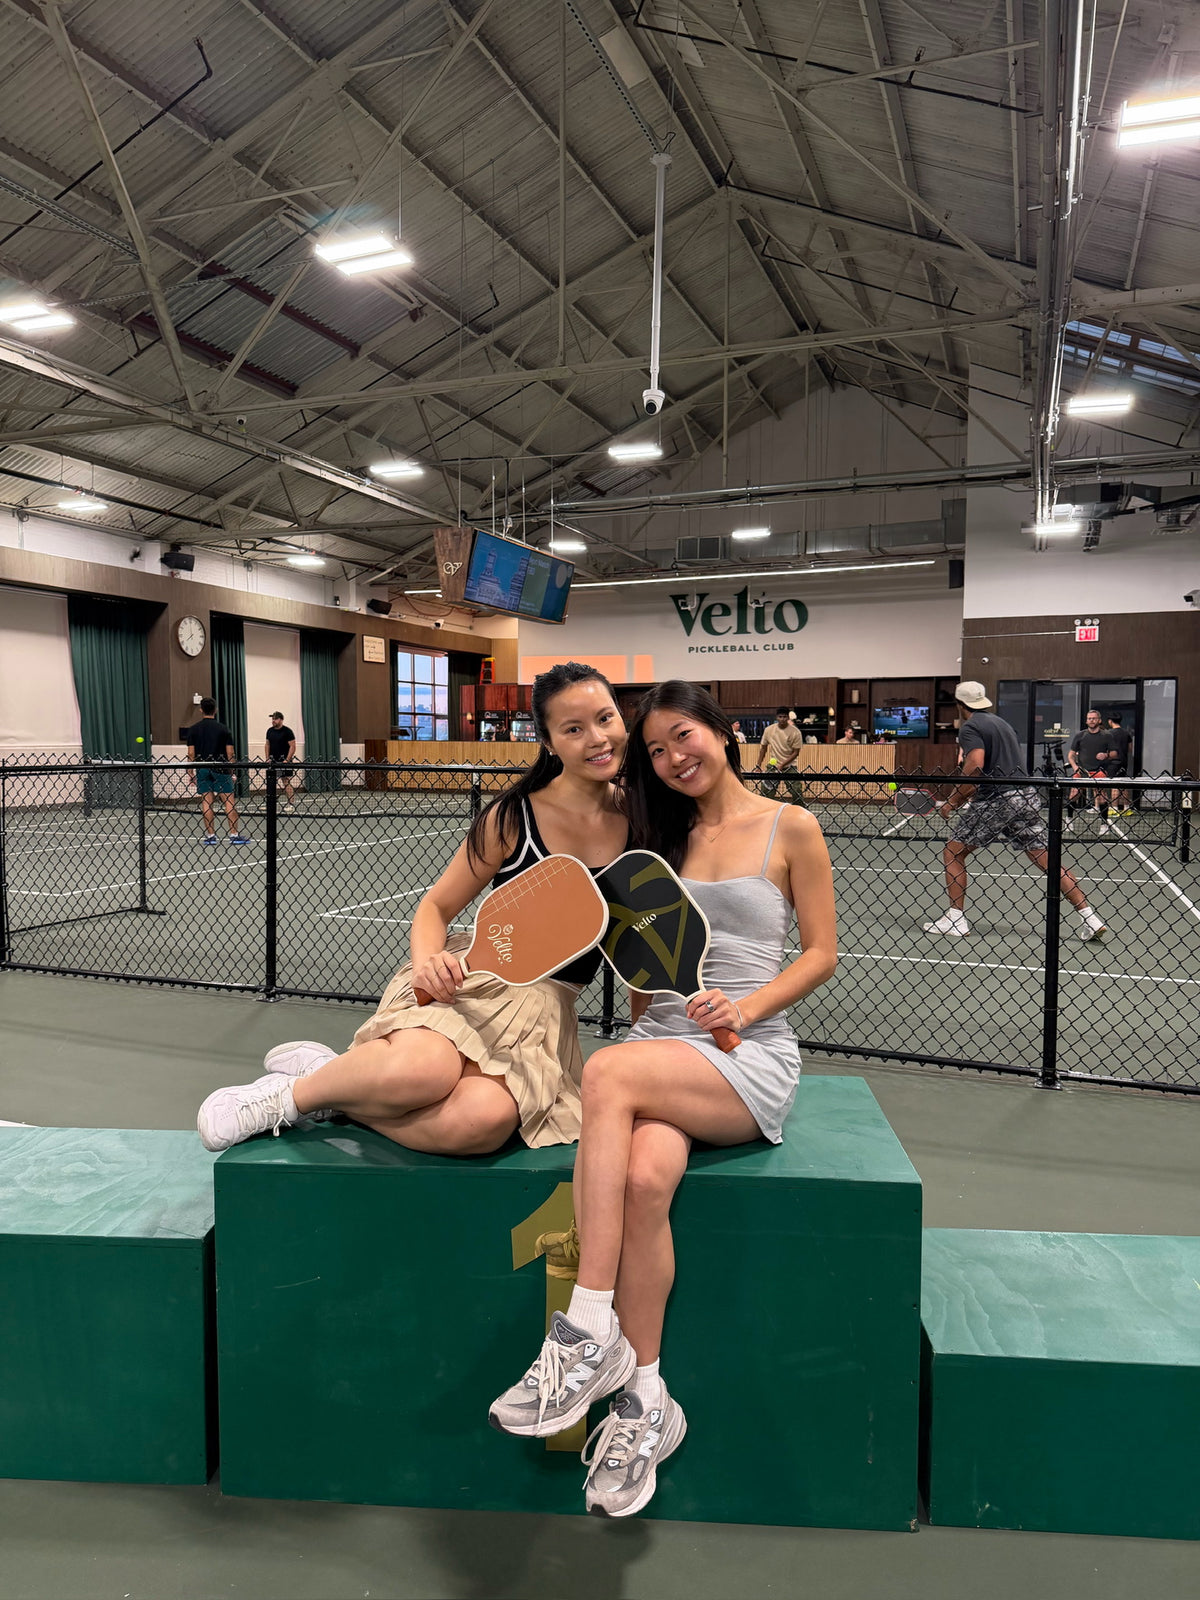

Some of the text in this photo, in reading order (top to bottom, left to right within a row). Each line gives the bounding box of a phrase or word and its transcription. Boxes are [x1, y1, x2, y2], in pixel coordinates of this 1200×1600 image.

[669, 585, 809, 637] Velto
[1078, 627, 1097, 641] EXIT
[687, 643, 795, 654] PICKLEBALL CLUB
[631, 913, 657, 933] Velto
[487, 923, 513, 963] Velto
